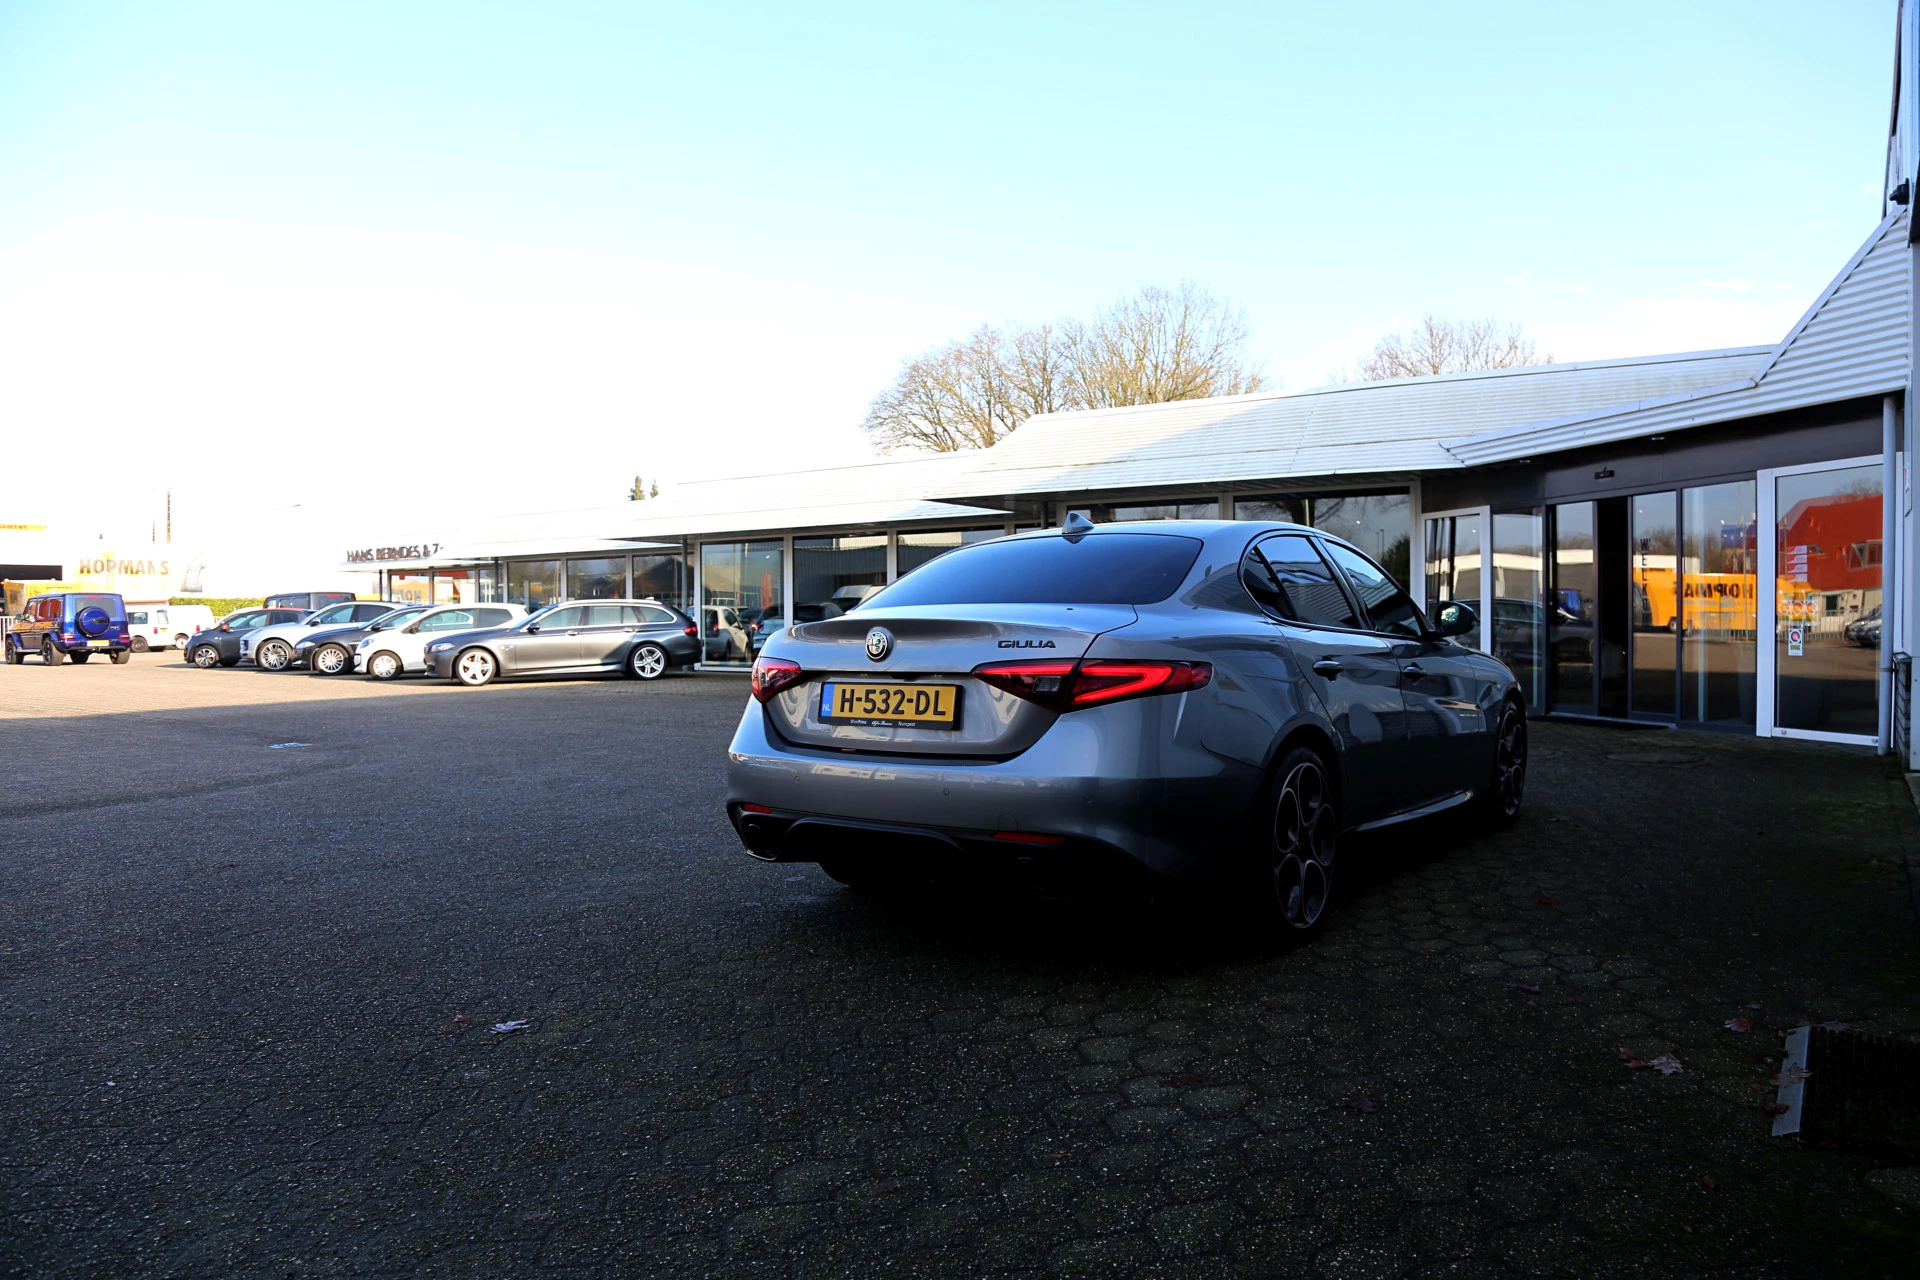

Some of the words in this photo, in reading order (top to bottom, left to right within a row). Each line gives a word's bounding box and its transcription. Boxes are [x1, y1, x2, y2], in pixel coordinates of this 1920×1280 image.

[346, 549, 374, 562] HANS
[79, 559, 169, 575] HOPMANS
[998, 640, 1056, 648] GIULIA
[840, 689, 946, 716] H-532-DL
